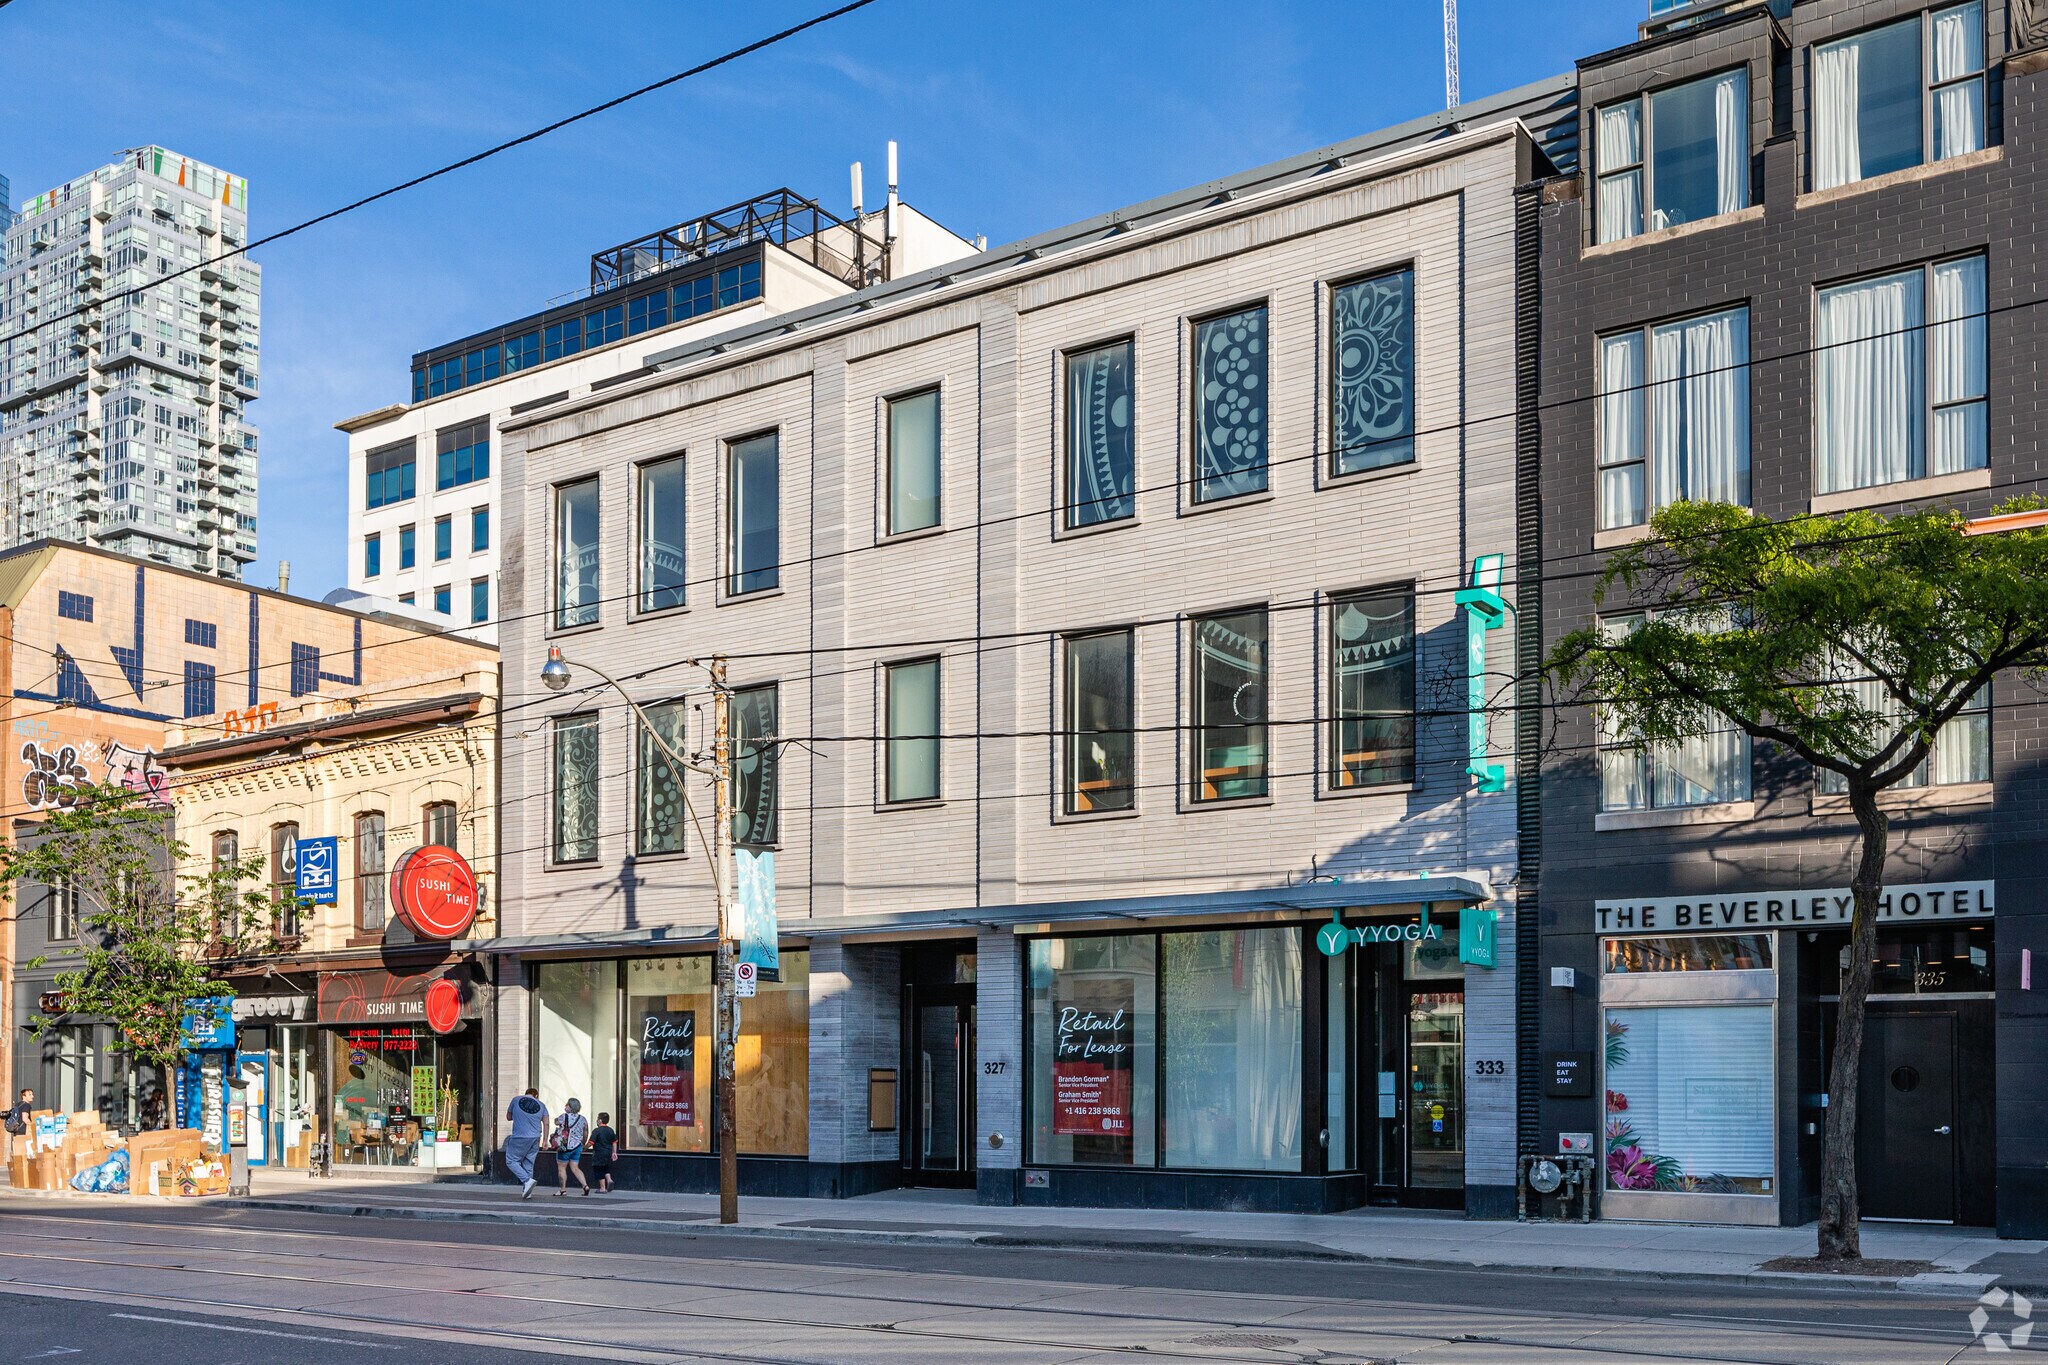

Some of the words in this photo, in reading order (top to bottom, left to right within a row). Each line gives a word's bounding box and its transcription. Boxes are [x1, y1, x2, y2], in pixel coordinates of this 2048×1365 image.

[420, 878, 450, 892] SUSHI
[446, 893, 470, 906] TIME
[1596, 906, 1655, 929] THE
[1676, 896, 1852, 926] BEVERLEY
[1876, 889, 1994, 916] HOTEL
[1355, 923, 1437, 947] YYOGA
[1915, 971, 1946, 987] 335
[232, 996, 310, 1022] groovy
[366, 1002, 396, 1016] SUSHI
[400, 1001, 424, 1014] TIME
[644, 1016, 692, 1041] Retail
[1058, 1006, 1126, 1036] Retail
[384, 1040, 418, 1050] 977-2222
[644, 1040, 660, 1059] For
[662, 1041, 693, 1061] Lease
[1058, 1034, 1082, 1056] For
[1084, 1035, 1126, 1058] Lease
[984, 1062, 1006, 1074] 327
[1475, 1060, 1504, 1075] 333
[1102, 1107, 1120, 1115] 9868
